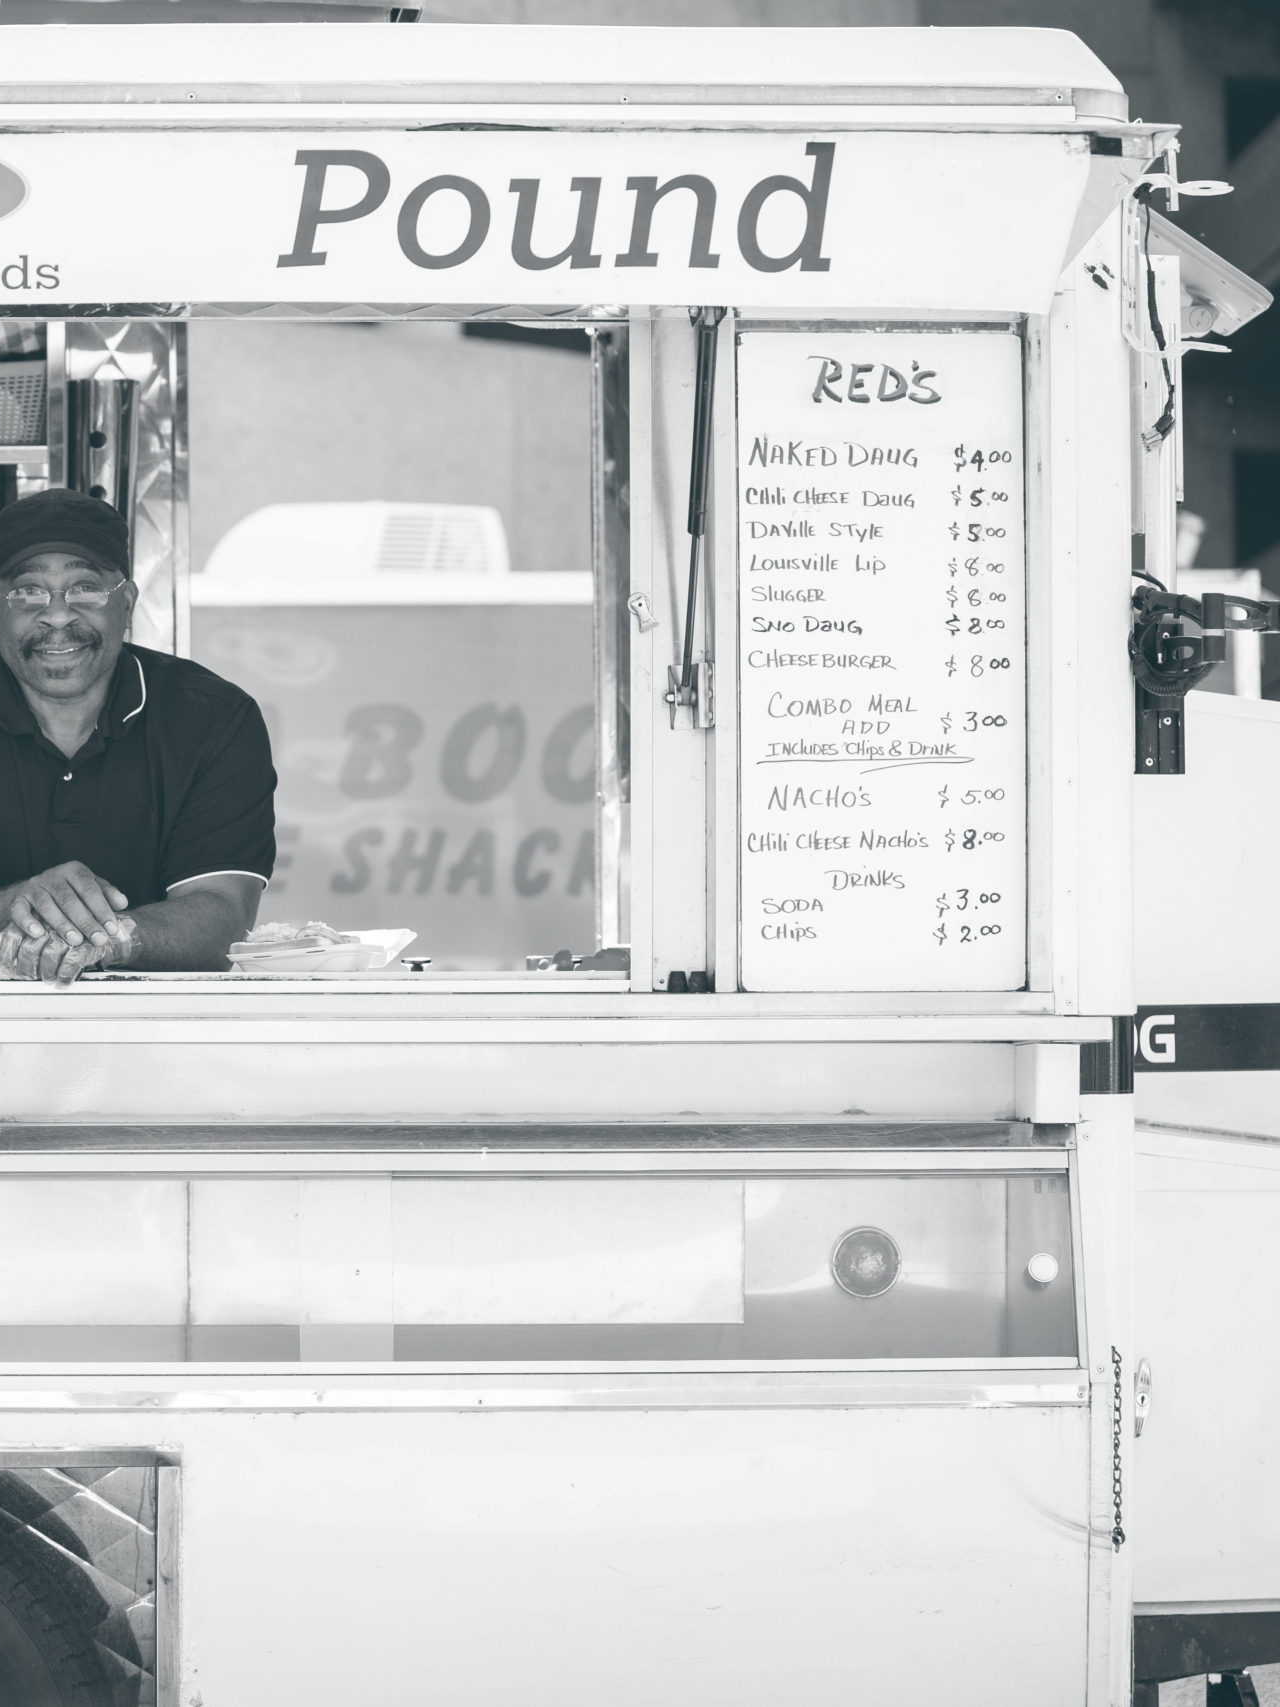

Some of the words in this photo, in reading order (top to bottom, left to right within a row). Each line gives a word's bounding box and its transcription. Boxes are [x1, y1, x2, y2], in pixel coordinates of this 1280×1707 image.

[276, 141, 836, 273] Pound
[807, 355, 942, 404] RED'S
[748, 435, 837, 467] NAKED
[844, 442, 919, 468] DAUG
[767, 691, 852, 718] COMBO
[867, 694, 919, 715] MEAL
[841, 719, 890, 735] ADD
[888, 740, 902, 756] &
[761, 898, 824, 914] SODA
